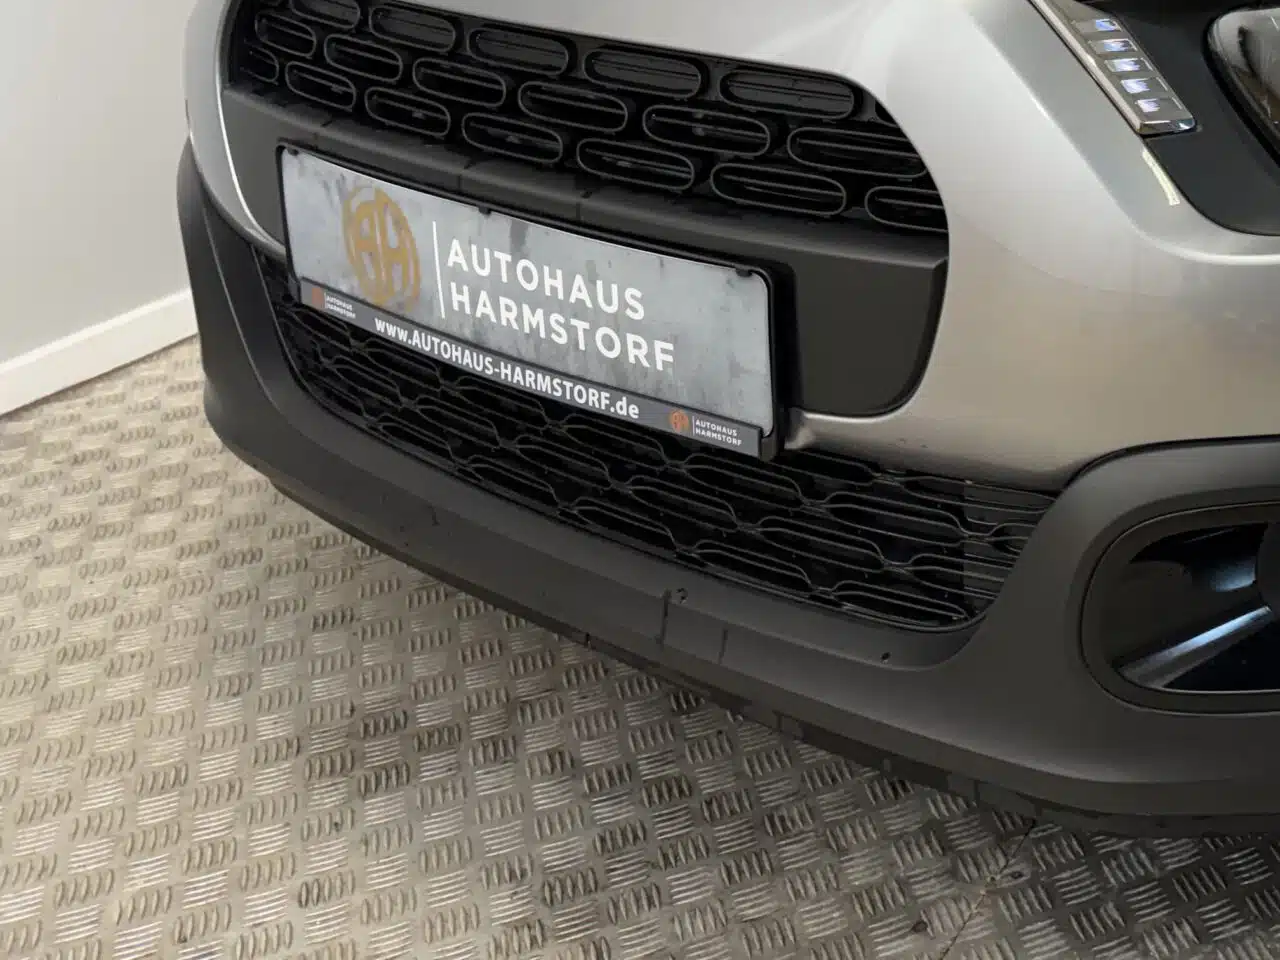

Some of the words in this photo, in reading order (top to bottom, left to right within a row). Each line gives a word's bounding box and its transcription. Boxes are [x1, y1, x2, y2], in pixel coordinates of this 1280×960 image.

[447, 238, 645, 320] AUTOHAUS
[450, 282, 675, 371] HARMSTORF
[374, 317, 640, 420] www.AUTOHAUS-HARMSTORF.de
[695, 419, 738, 437] AUTOHAUS
[695, 427, 742, 446] HARMSTORF
